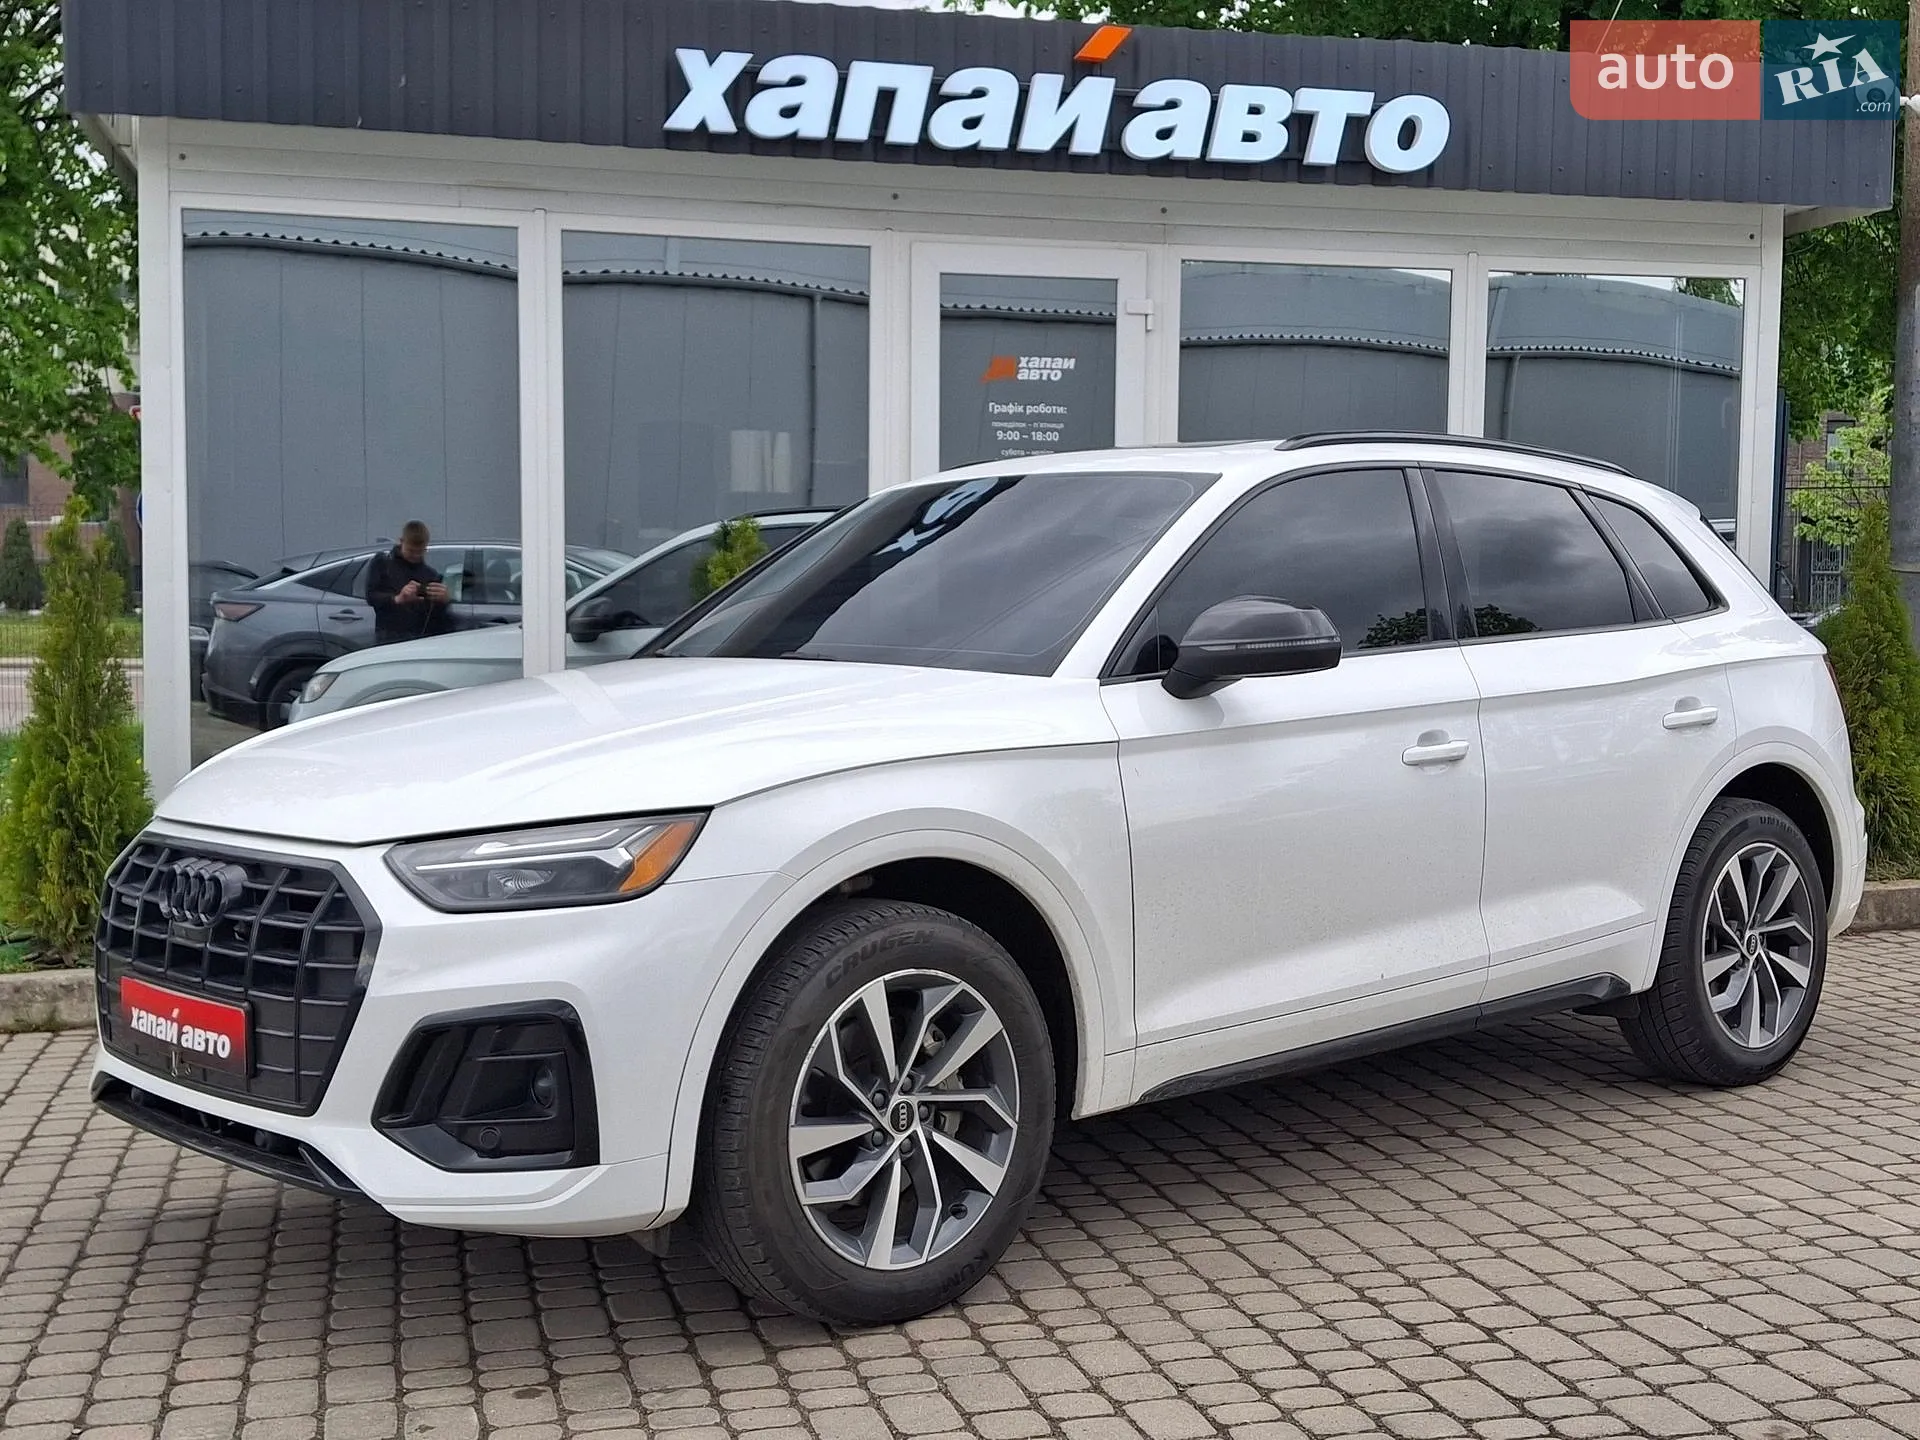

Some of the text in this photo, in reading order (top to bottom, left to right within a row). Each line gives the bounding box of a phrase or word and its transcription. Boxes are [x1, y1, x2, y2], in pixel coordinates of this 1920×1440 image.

[1121, 78, 1451, 174] авто
[1016, 369, 1062, 381] авто
[988, 402, 1068, 415] Графік роботи:
[996, 430, 1020, 441] 9:00
[1031, 431, 1060, 441] 18:00
[825, 929, 935, 989] CRUGEN
[181, 1024, 231, 1059] авто
